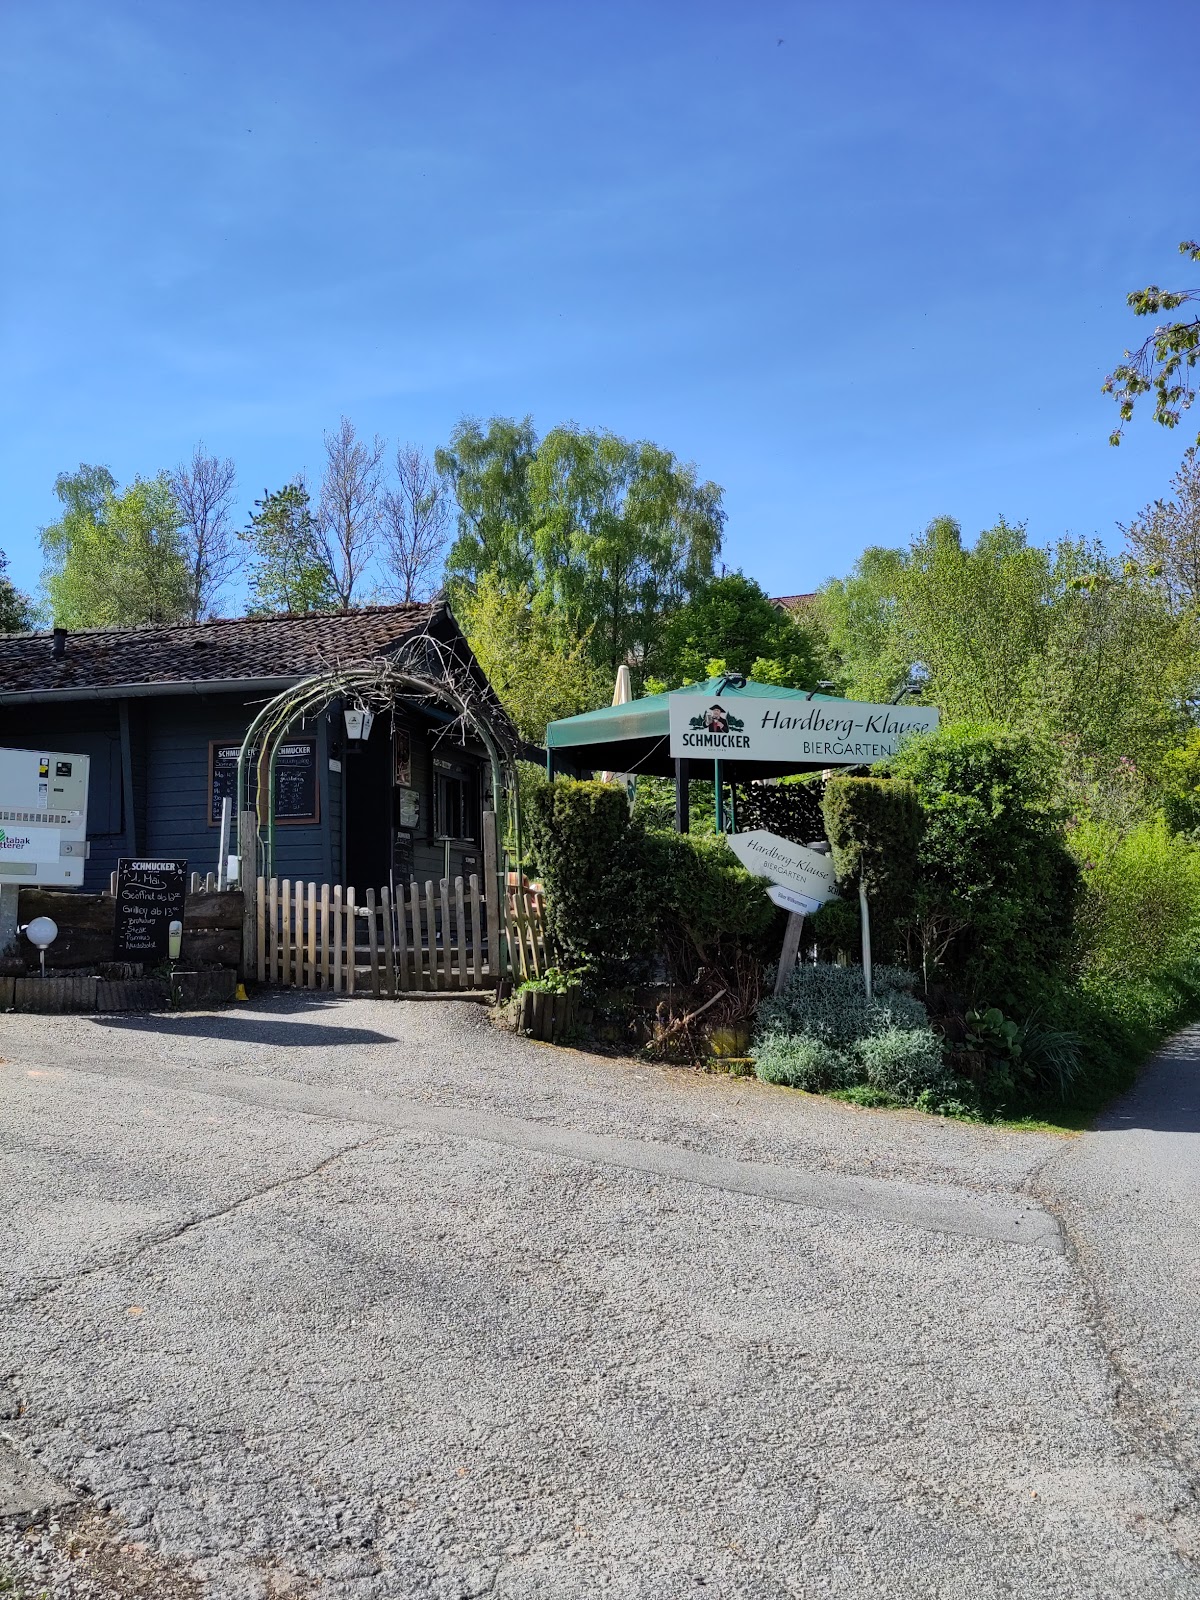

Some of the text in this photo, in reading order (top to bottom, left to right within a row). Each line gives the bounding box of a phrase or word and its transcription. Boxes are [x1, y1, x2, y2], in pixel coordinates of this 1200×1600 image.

[761, 708, 930, 741] Hardberg-Klause
[682, 733, 750, 749] SCHMUCKER
[803, 741, 891, 756] BIERGARTEN
[6, 836, 31, 845] tabak
[131, 862, 176, 871] SCHMUCKER
[746, 839, 829, 880] Hardberg-Klause
[143, 873, 160, 885] Mai
[763, 860, 807, 884] BIERGARTEN
